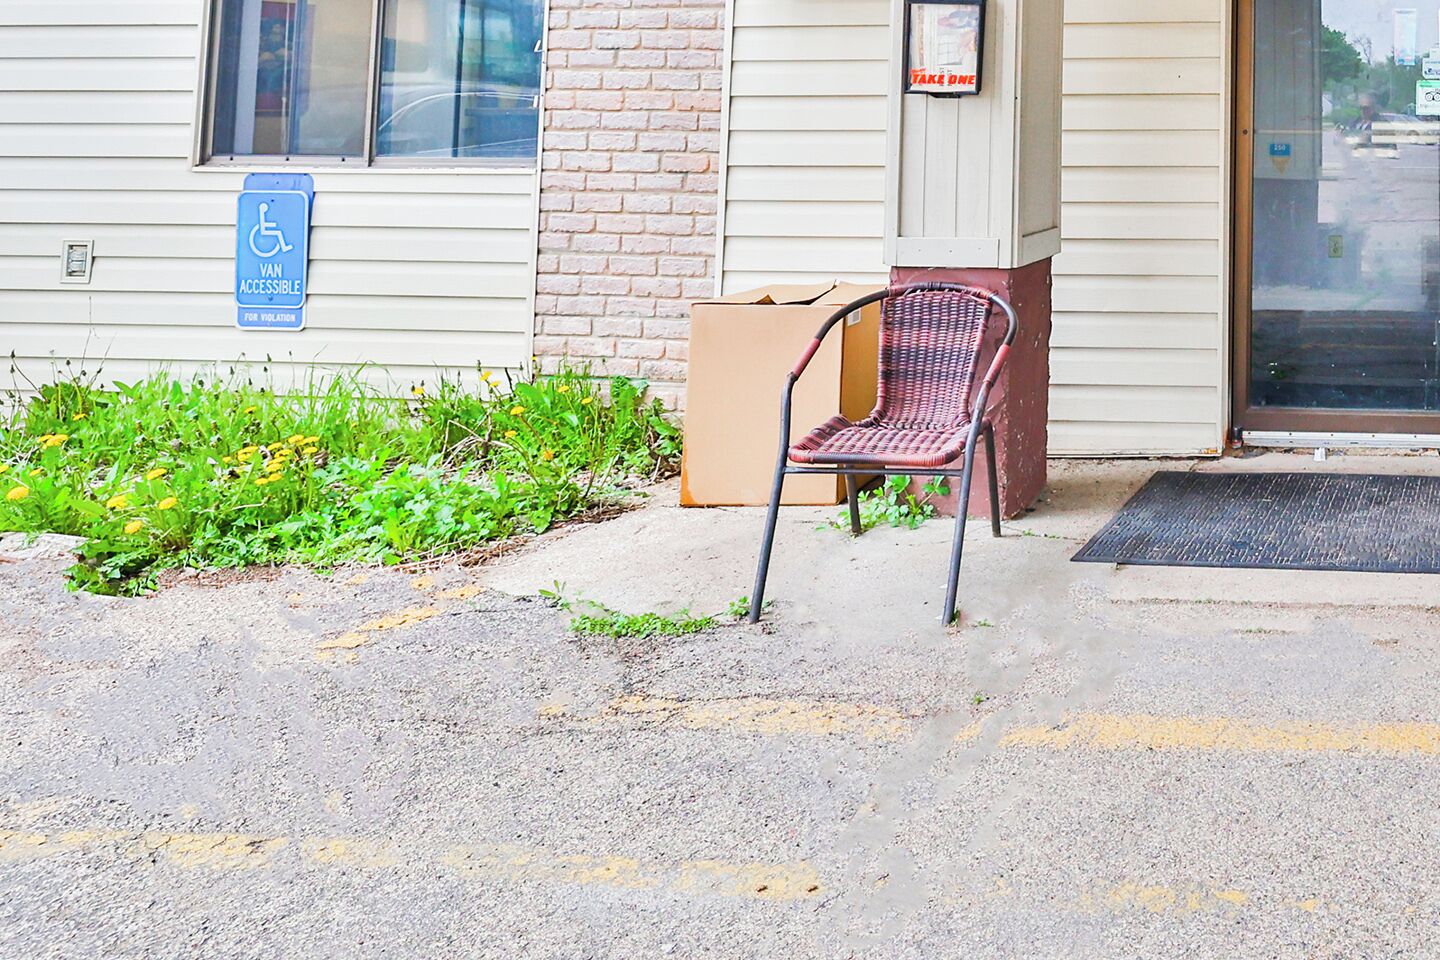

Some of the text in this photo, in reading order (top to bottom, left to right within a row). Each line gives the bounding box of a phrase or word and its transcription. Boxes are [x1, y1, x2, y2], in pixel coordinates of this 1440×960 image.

[911, 73, 976, 85] TAKE ONE
[259, 263, 282, 278] VAN
[239, 279, 301, 295] ACCESSIBLE
[244, 313, 296, 322] FOR VIOLATION
